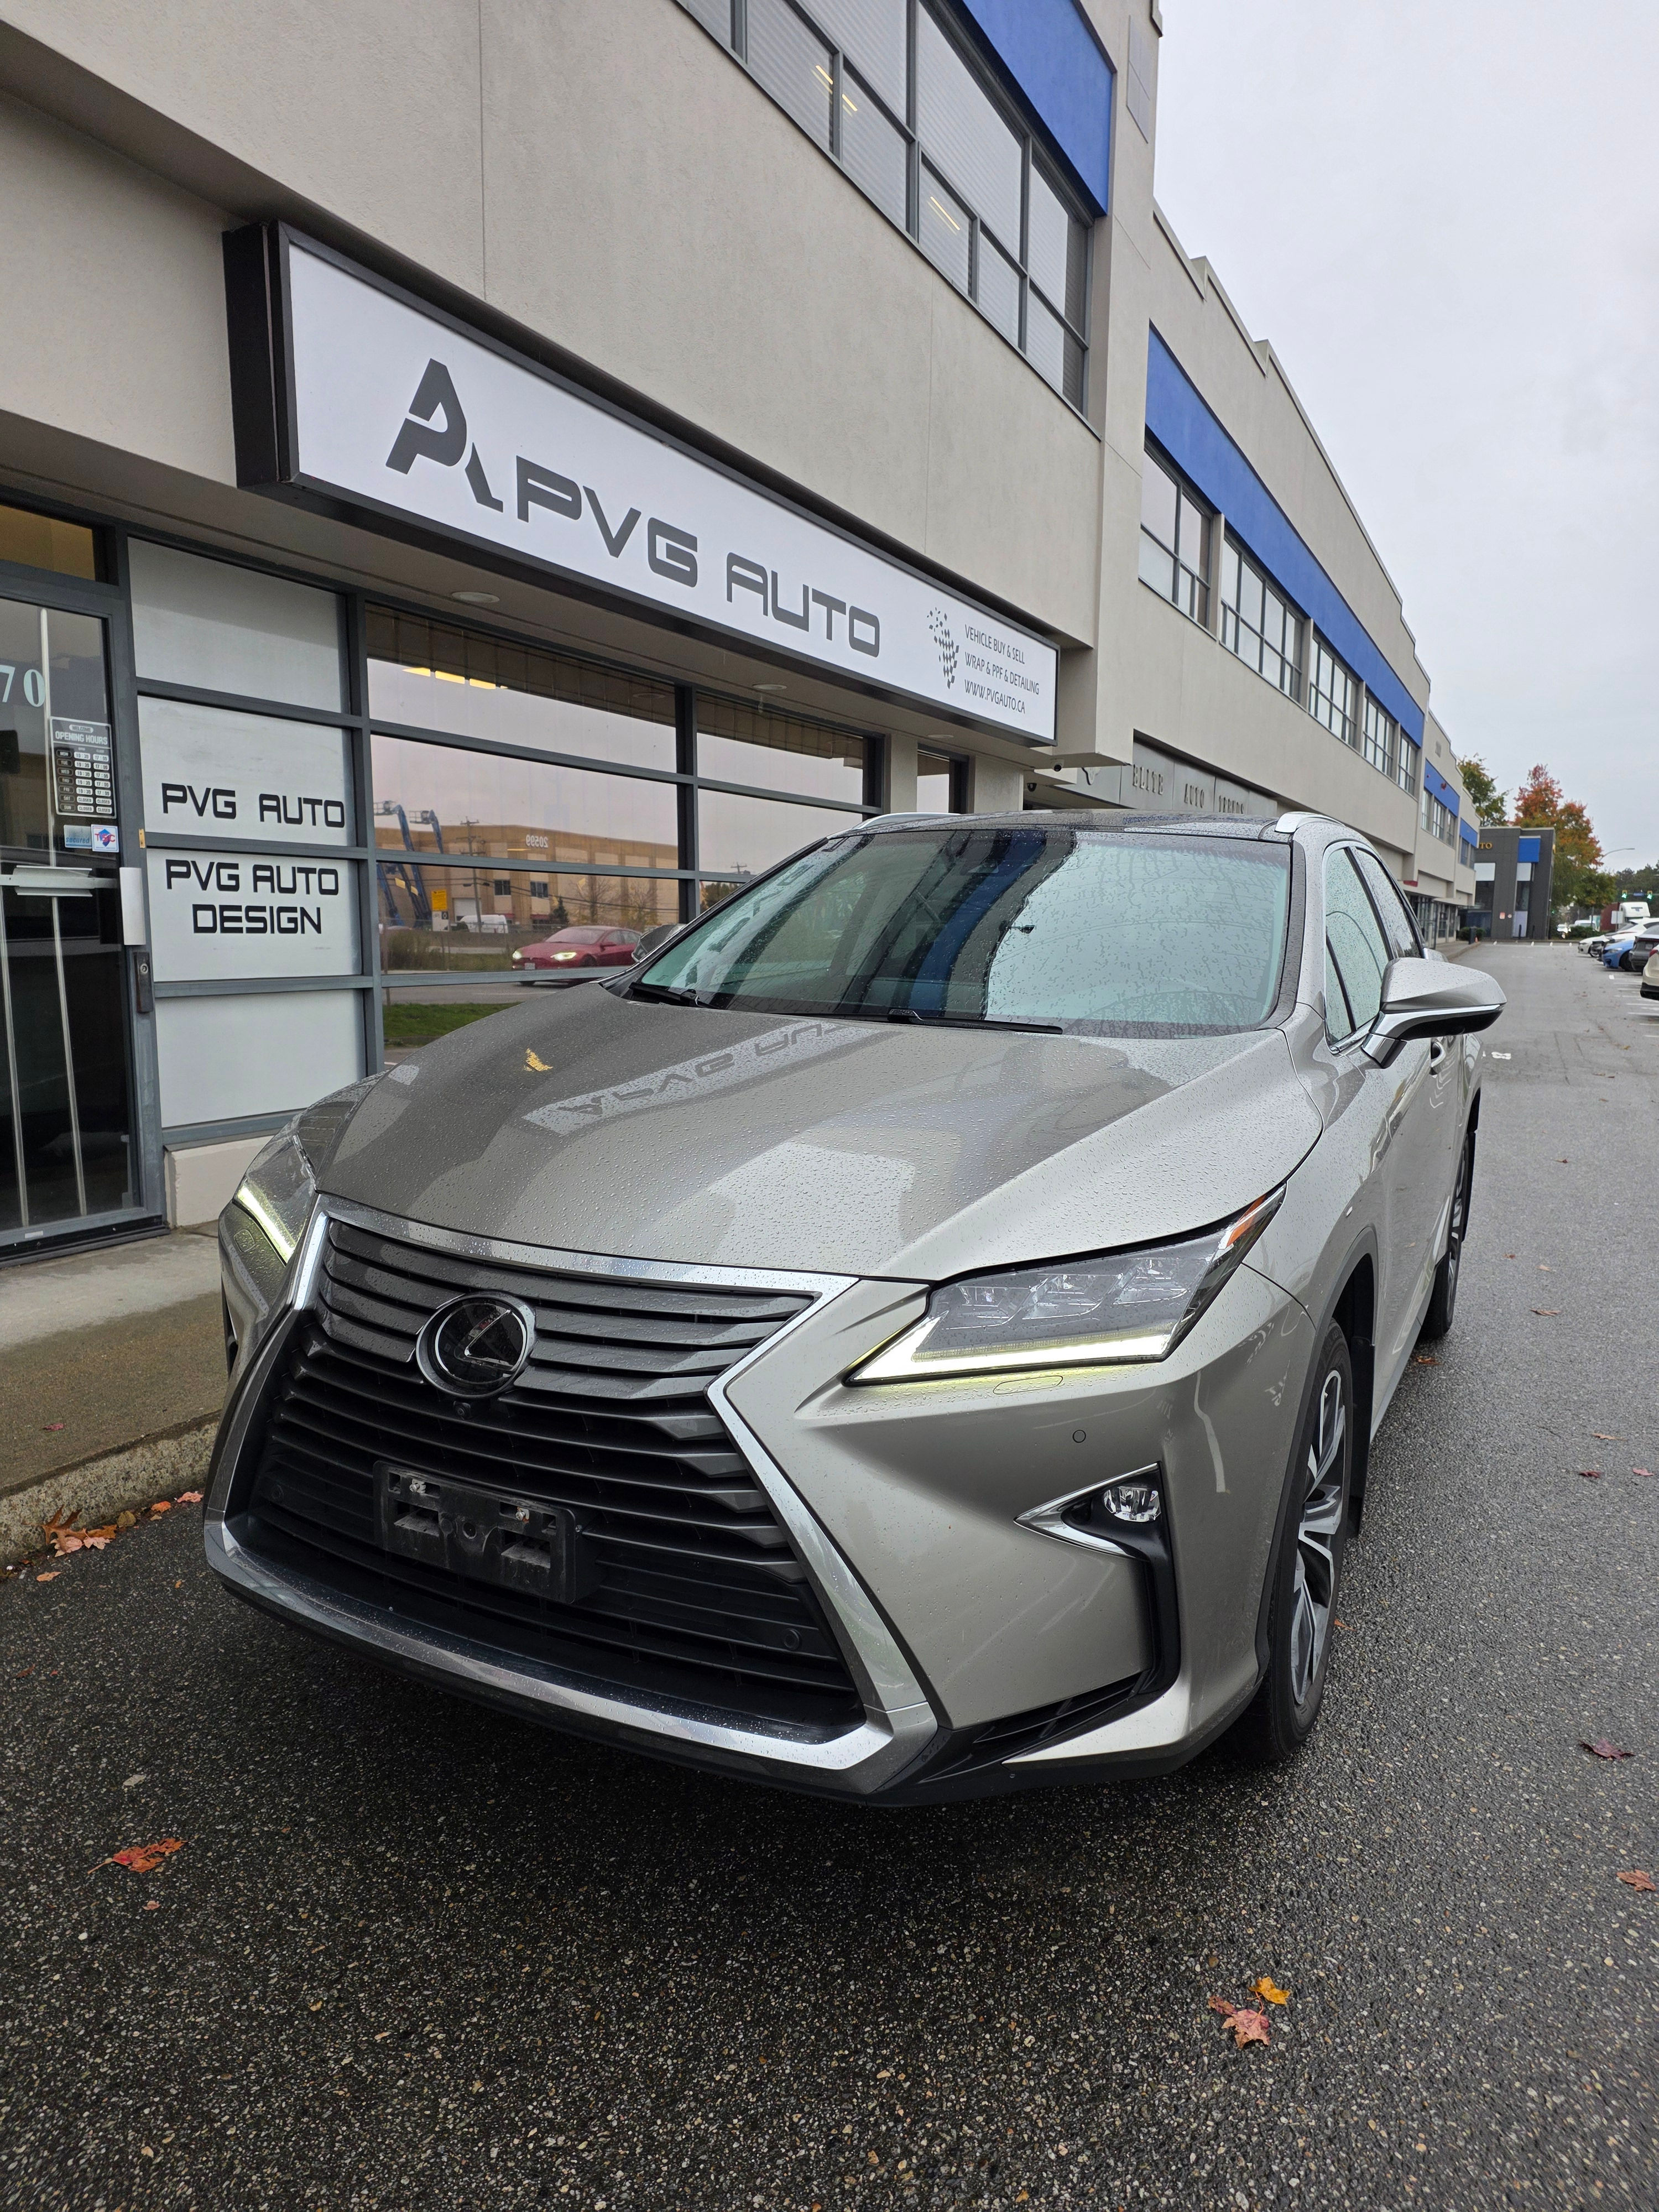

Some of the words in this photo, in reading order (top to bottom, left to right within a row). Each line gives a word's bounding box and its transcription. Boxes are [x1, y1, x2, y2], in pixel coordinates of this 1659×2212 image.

[516, 455, 698, 588] PVG
[726, 552, 880, 658] AUTO
[965, 624, 992, 649] VEHICLE
[993, 639, 1006, 655] BUY
[1007, 645, 1011, 659] &
[1012, 648, 1025, 664] SELL
[965, 651, 985, 671] WRAP
[986, 662, 990, 676] &
[992, 664, 1003, 680] PPF
[1004, 669, 1009, 682] &
[1010, 671, 1039, 695] DETAILING
[964, 679, 1025, 714] WWW.PVGAUTO.CA
[55, 731, 85, 742] OPENING
[85, 734, 108, 745] HOURS
[161, 782, 237, 820] PVG
[259, 793, 345, 828] AUTO
[165, 859, 239, 892] PVG
[252, 864, 339, 896] AUTO
[192, 904, 322, 935] DESIGN
